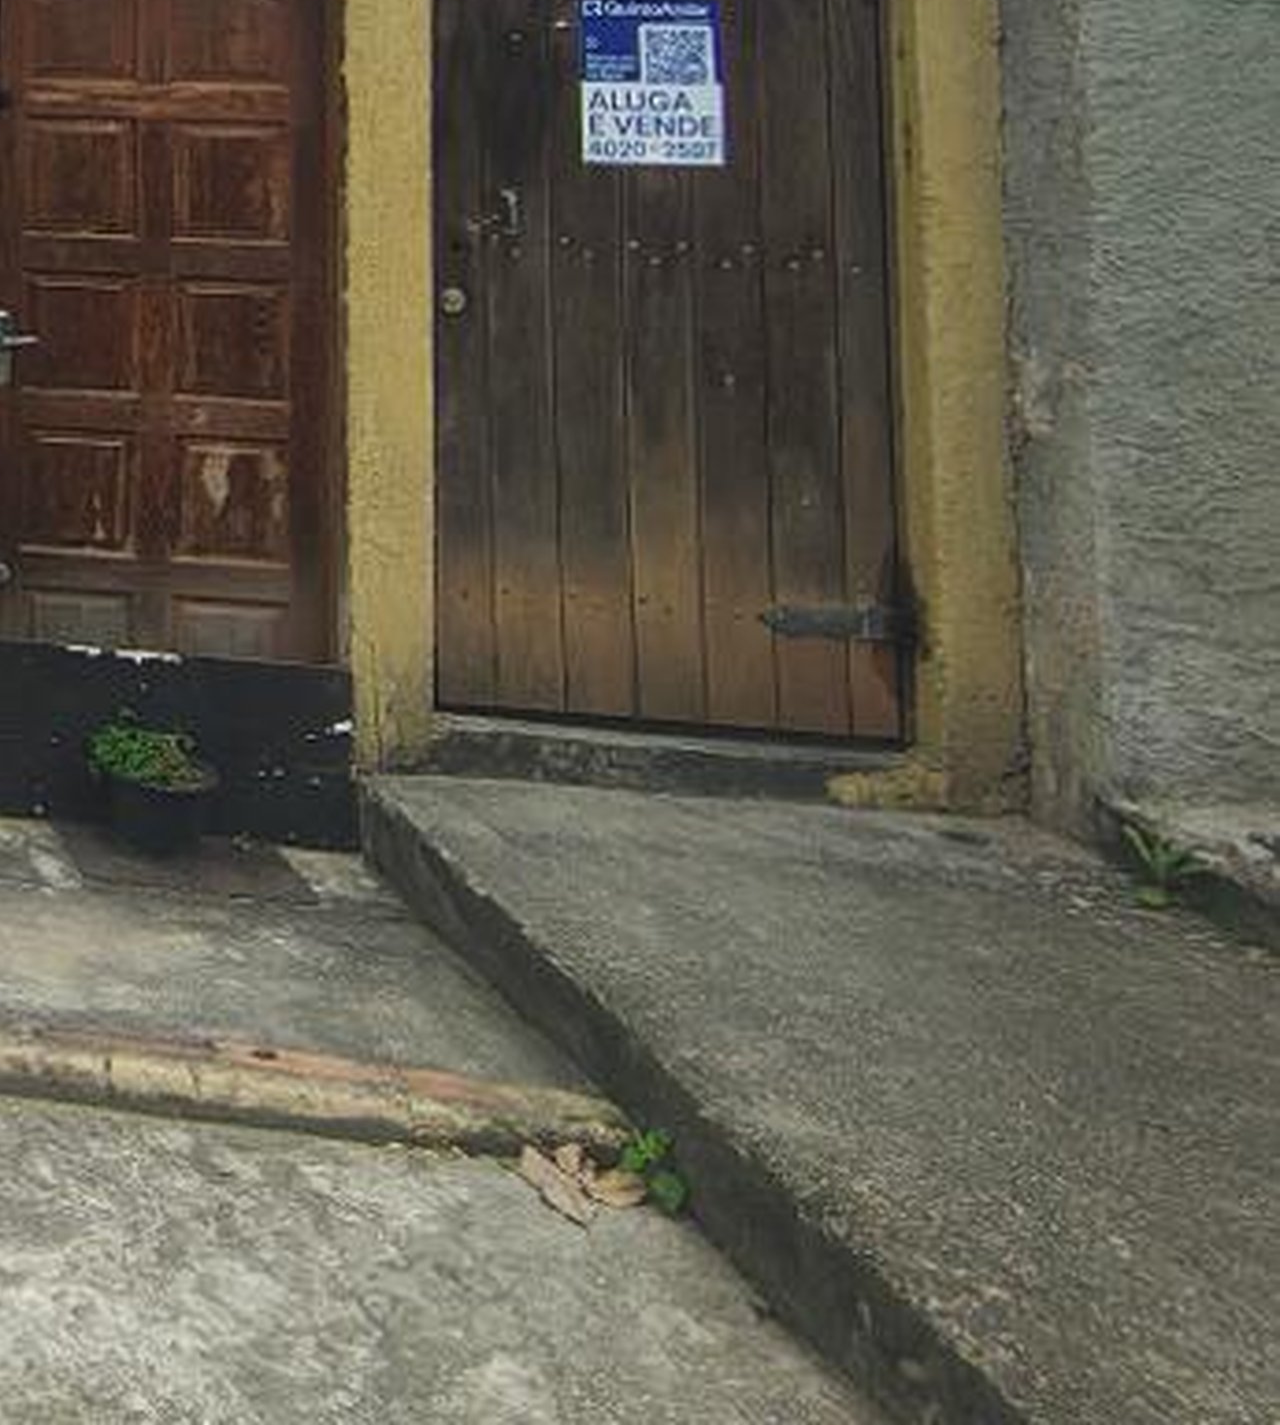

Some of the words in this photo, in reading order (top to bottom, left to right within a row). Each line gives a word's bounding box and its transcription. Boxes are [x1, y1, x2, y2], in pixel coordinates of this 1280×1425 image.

[589, 90, 693, 112] ALUGA
[589, 115, 606, 136] E
[614, 116, 718, 138] VENDE
